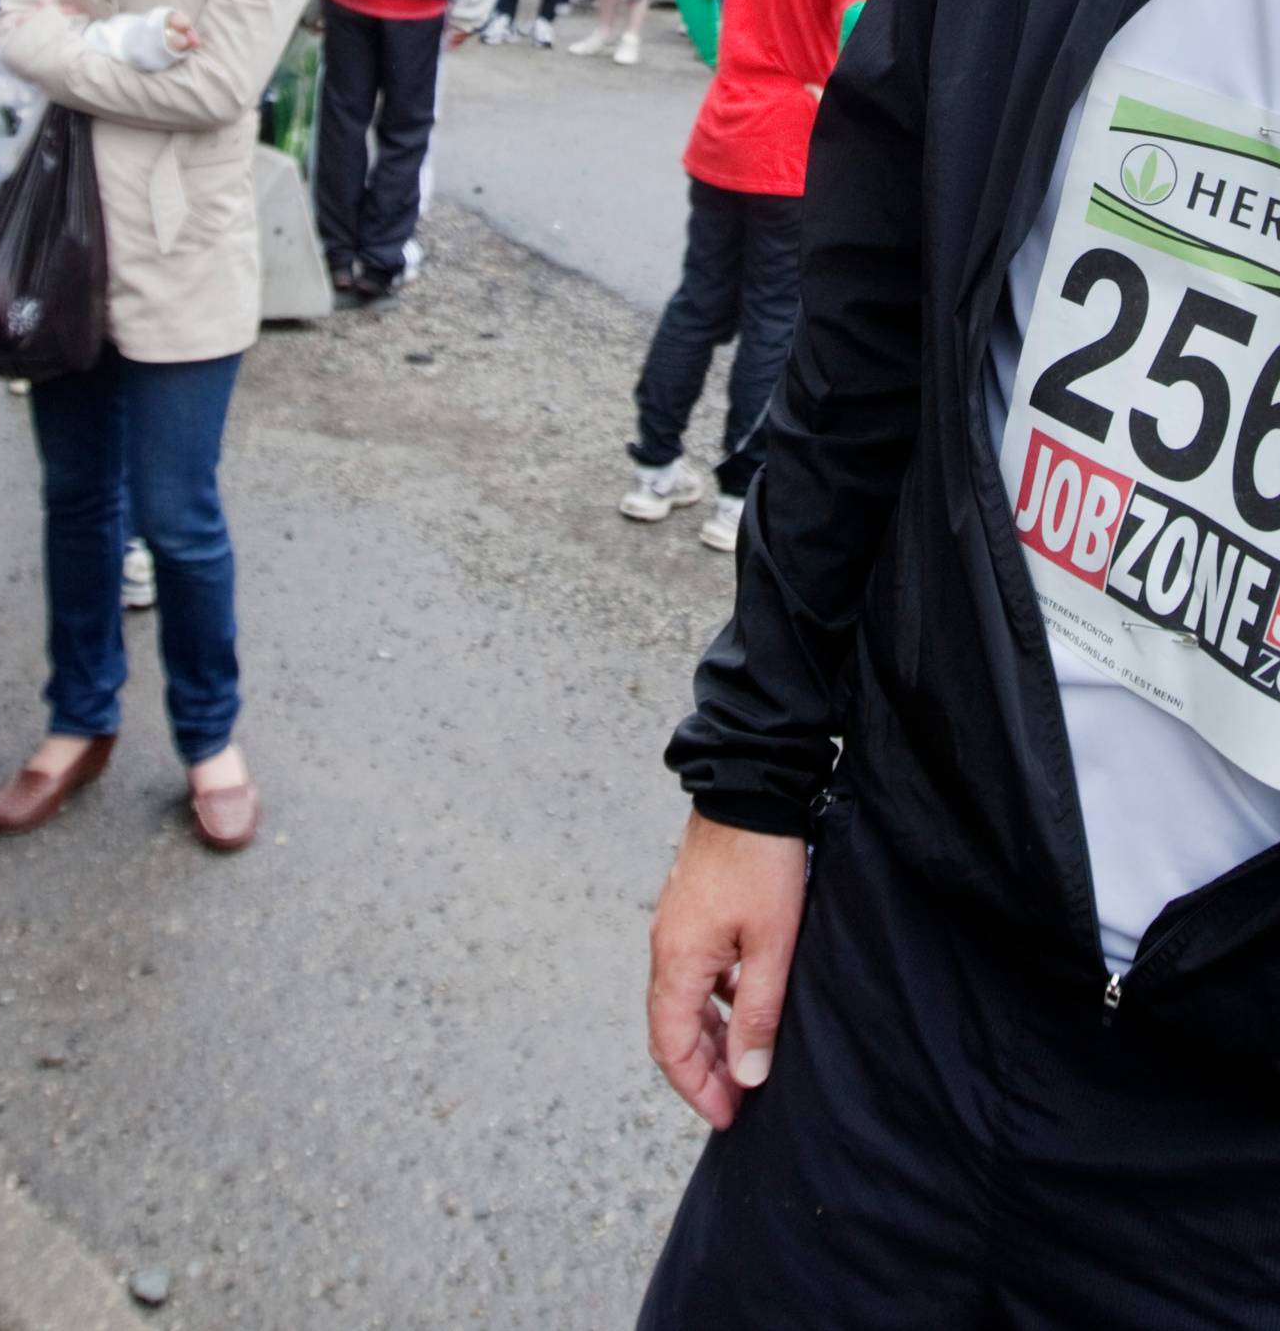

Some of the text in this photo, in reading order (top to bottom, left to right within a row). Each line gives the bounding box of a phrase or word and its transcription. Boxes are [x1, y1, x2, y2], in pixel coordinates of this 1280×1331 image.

[1081, 620, 1115, 647] KONTOR
[1121, 668, 1153, 693] (FLEST
[1153, 686, 1185, 711] MENN)
